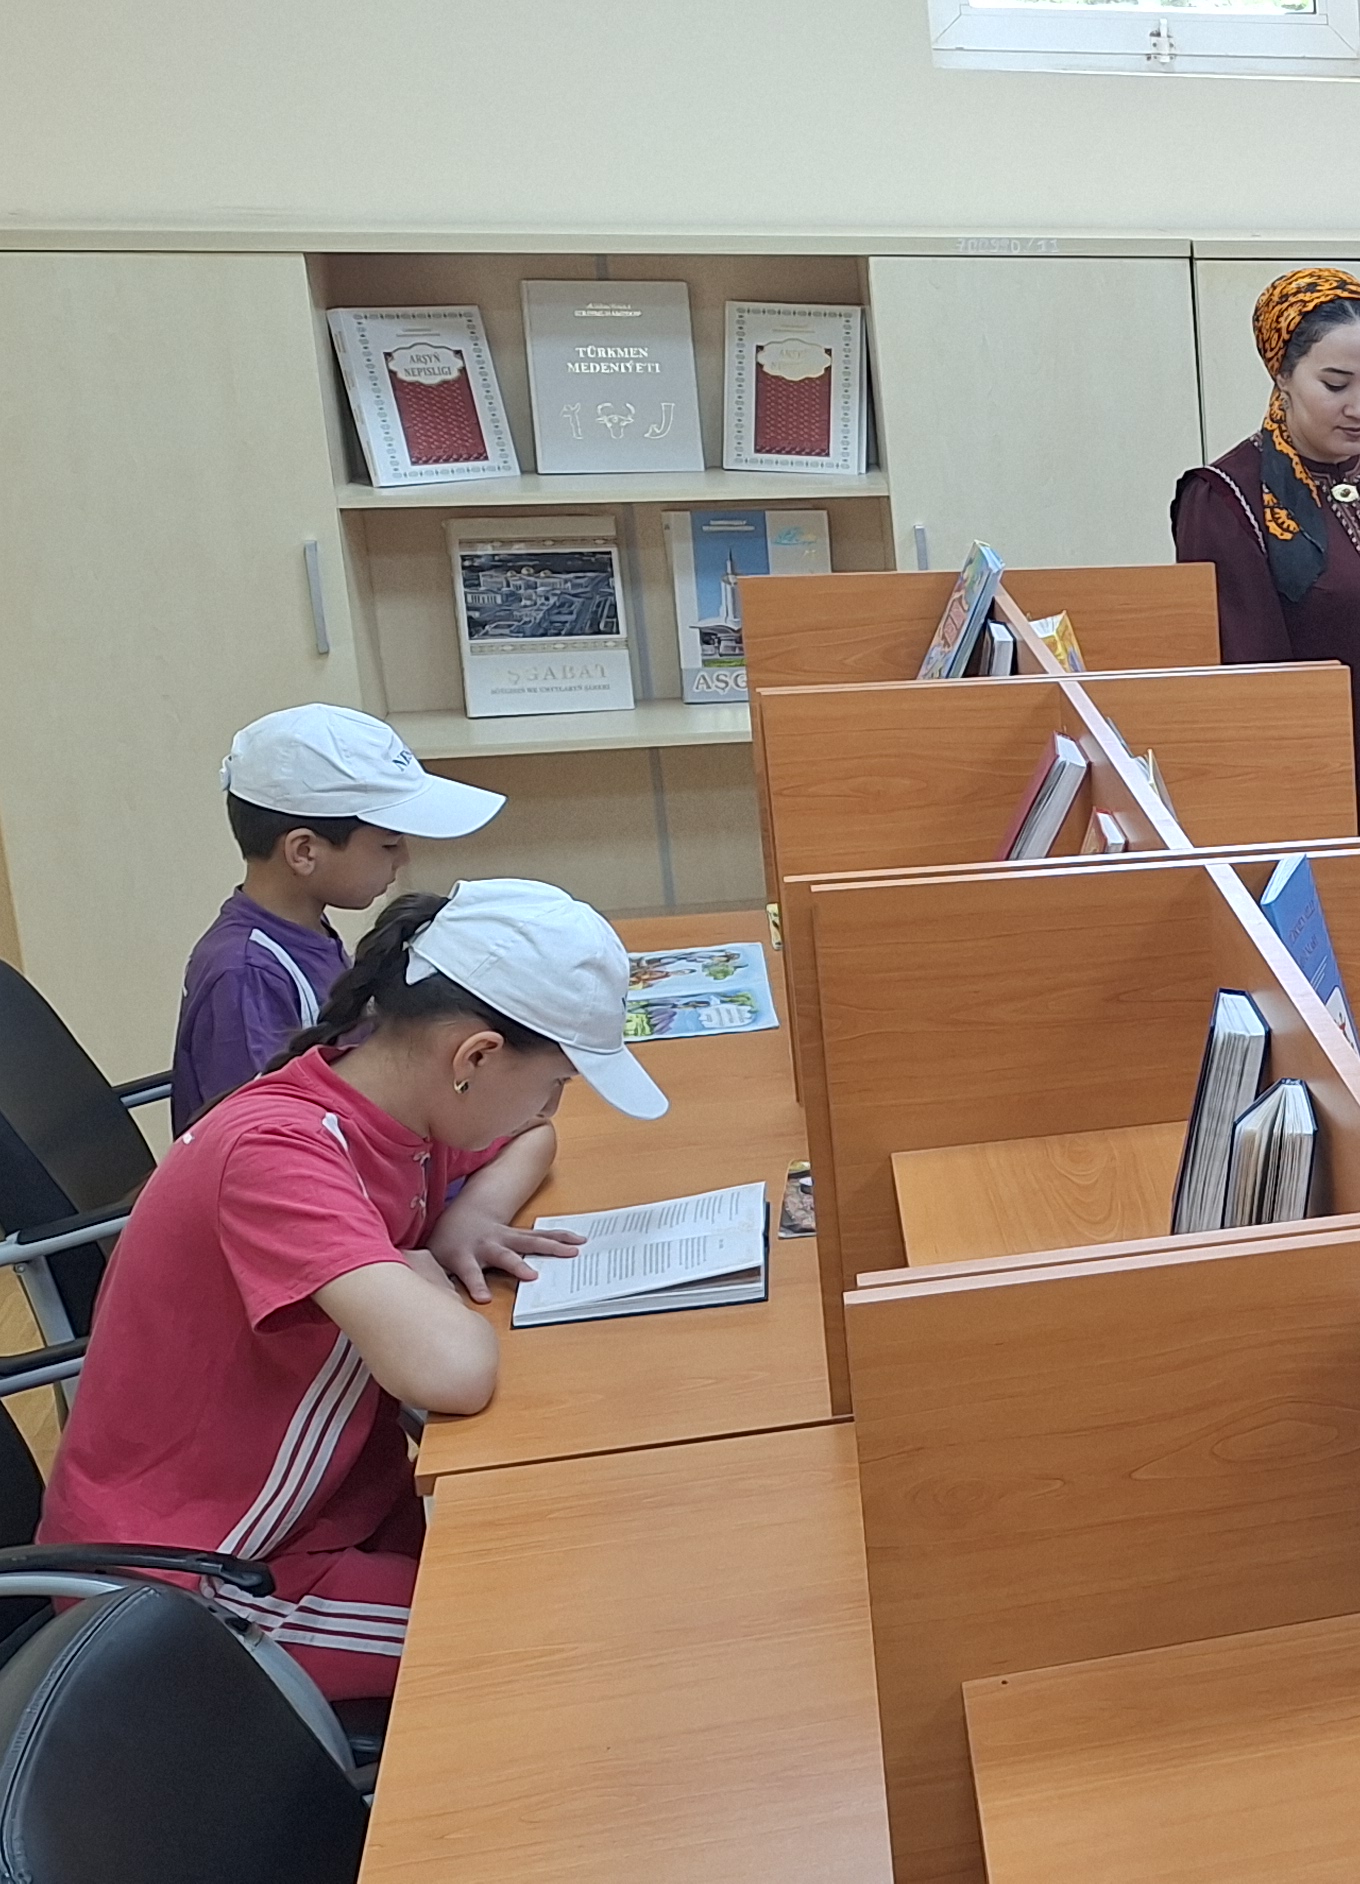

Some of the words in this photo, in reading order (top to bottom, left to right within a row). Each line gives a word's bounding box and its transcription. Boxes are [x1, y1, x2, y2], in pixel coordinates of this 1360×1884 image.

[575, 345, 648, 358] TÜRKMEN
[566, 360, 660, 373] MEDENIÝETI
[494, 663, 607, 685] ŞGABAT
